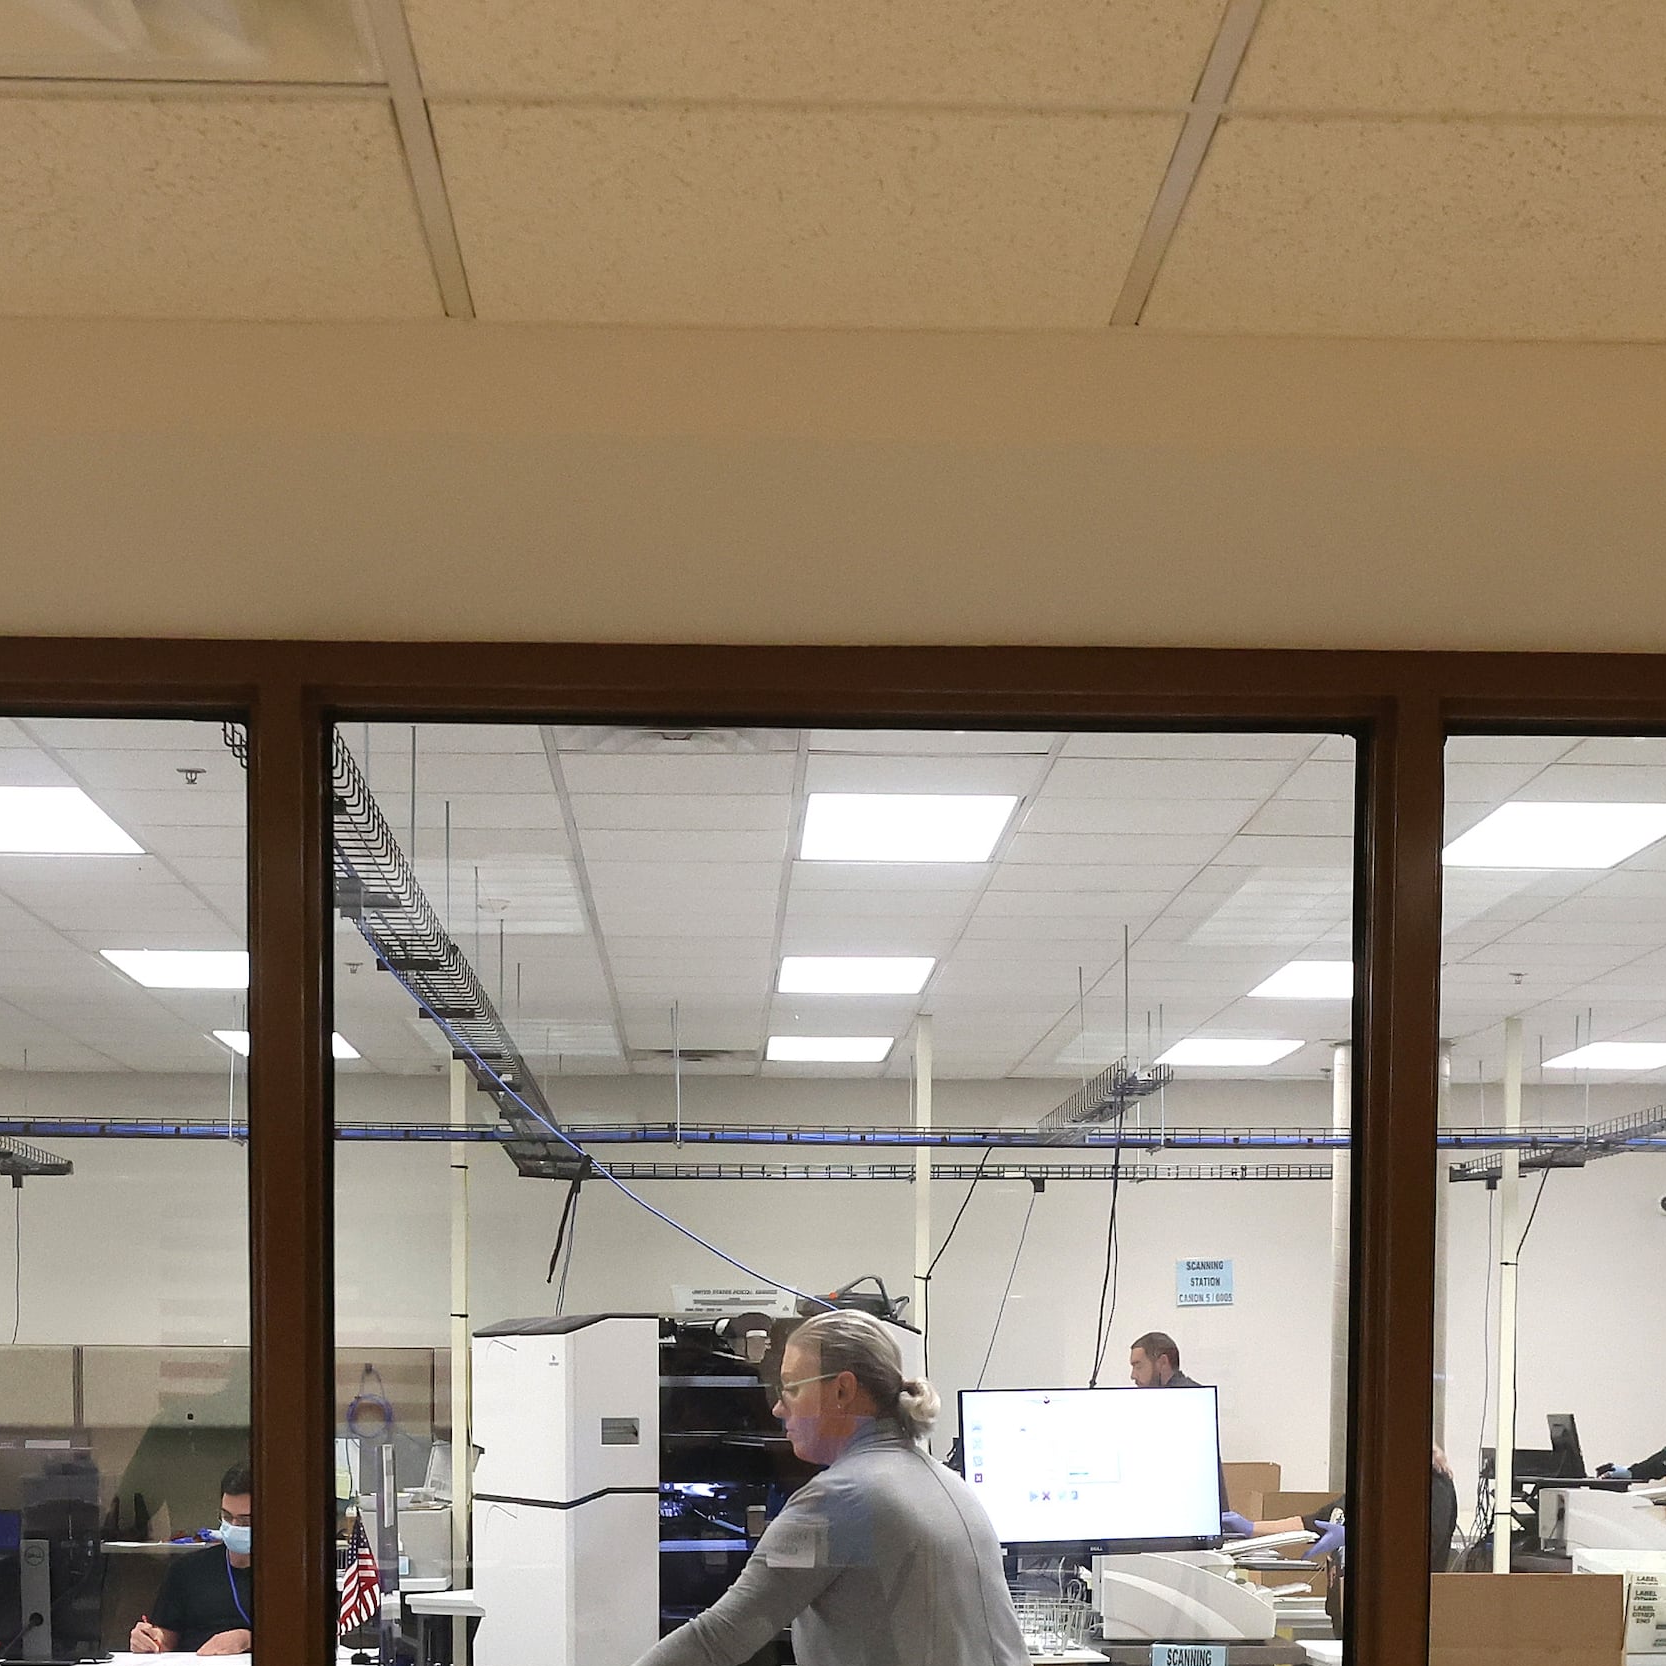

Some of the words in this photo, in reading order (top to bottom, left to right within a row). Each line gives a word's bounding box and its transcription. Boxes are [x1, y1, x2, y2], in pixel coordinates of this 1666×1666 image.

[1186, 1260, 1224, 1270] SCANNING
[1190, 1277, 1220, 1287] STATION
[1179, 1294, 1203, 1302] CANON
[1166, 1648, 1212, 1666] SCANNING
